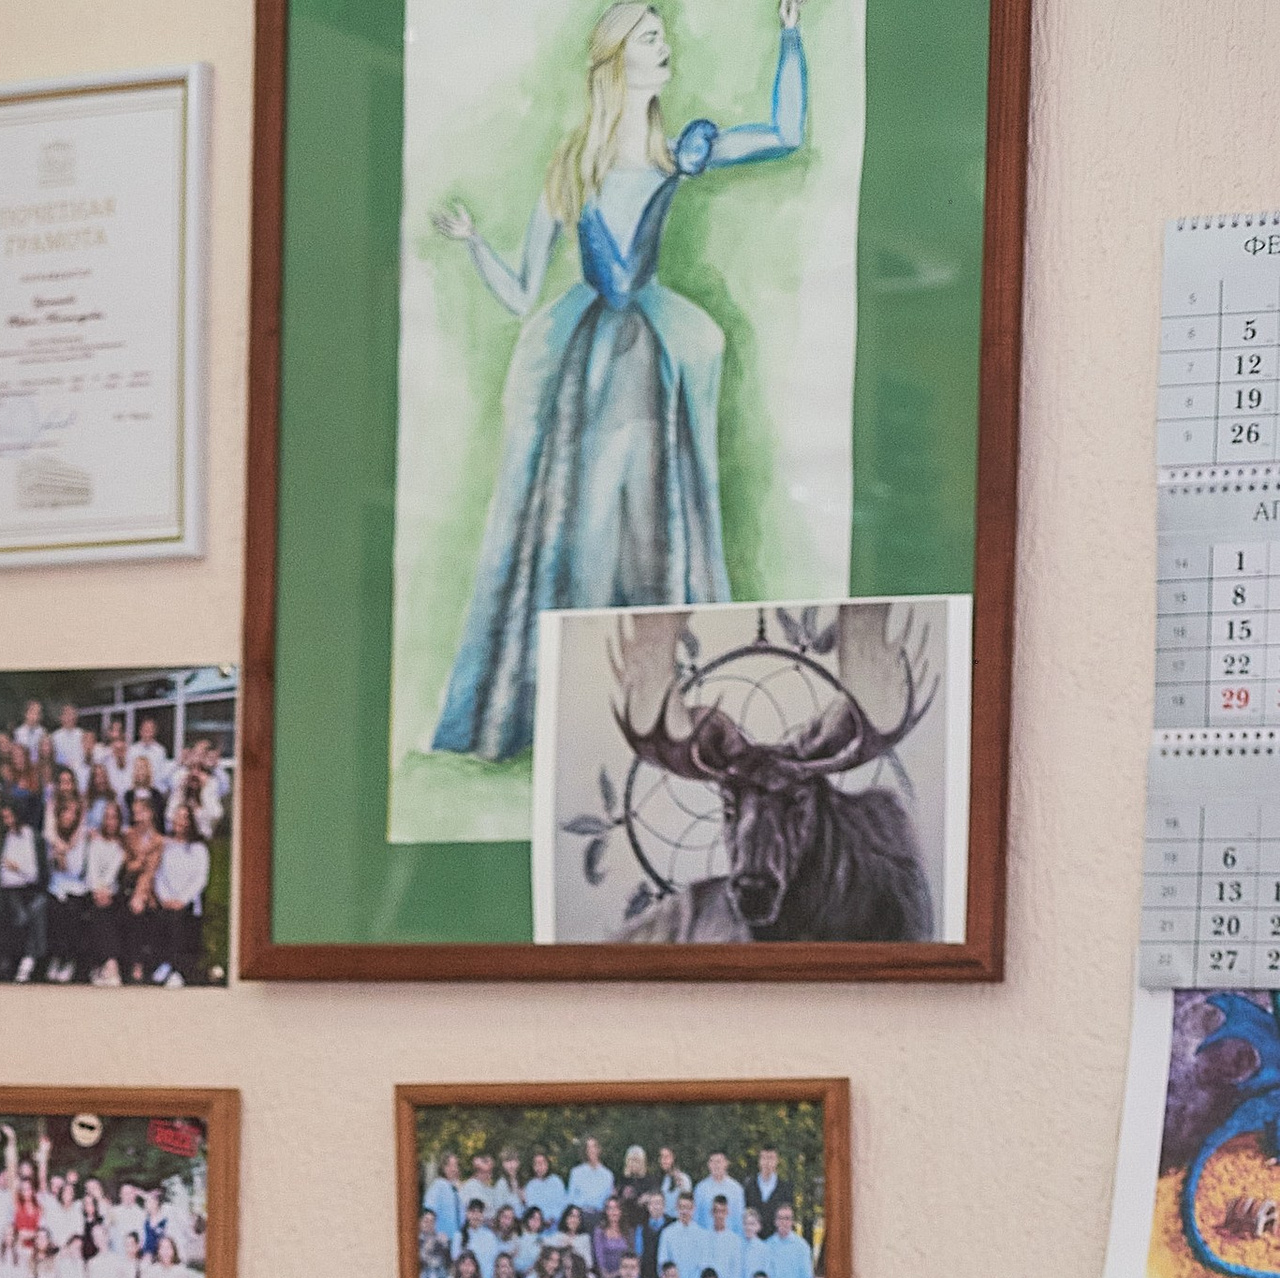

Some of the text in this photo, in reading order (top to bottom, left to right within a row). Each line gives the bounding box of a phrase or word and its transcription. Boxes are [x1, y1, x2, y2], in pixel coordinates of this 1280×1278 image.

[1243, 319, 1257, 340] 5
[1235, 353, 1262, 375] 12
[1235, 387, 1262, 409] 19
[1231, 422, 1261, 444] 26
[1236, 550, 1244, 571] 1
[1232, 584, 1246, 606] 8
[1228, 619, 1252, 640] 15
[1223, 653, 1251, 675] 22
[1222, 687, 1250, 709] 29
[1222, 846, 1237, 869] 6
[1218, 881, 1242, 902] 13
[1212, 914, 1240, 936] 20
[1210, 949, 1238, 971] 27
